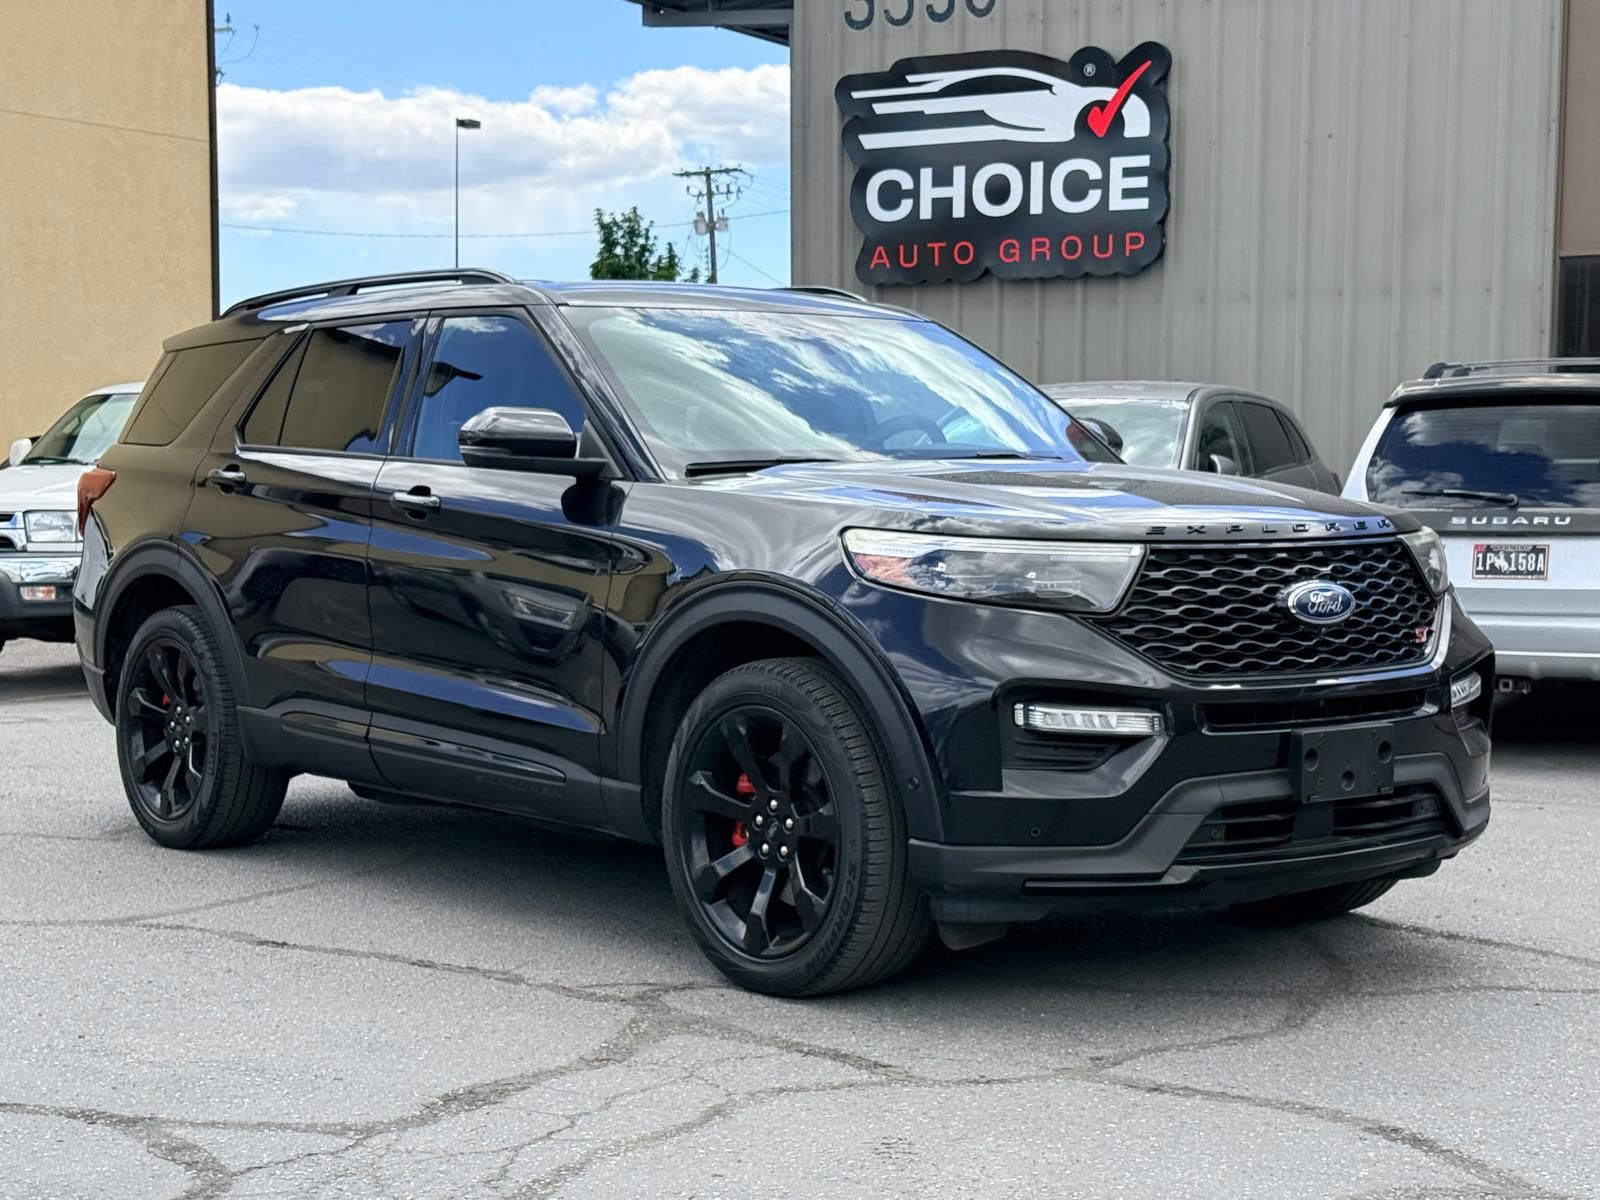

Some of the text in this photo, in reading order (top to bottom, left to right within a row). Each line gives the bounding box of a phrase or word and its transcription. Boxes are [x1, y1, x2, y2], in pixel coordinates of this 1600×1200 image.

[865, 155, 1151, 222] CHOICE
[869, 231, 1146, 270] AUTO GROUP
[1145, 518, 1392, 536] EXPLORER
[1451, 516, 1572, 525] SUBARU
[1308, 590, 1343, 614] Ford
